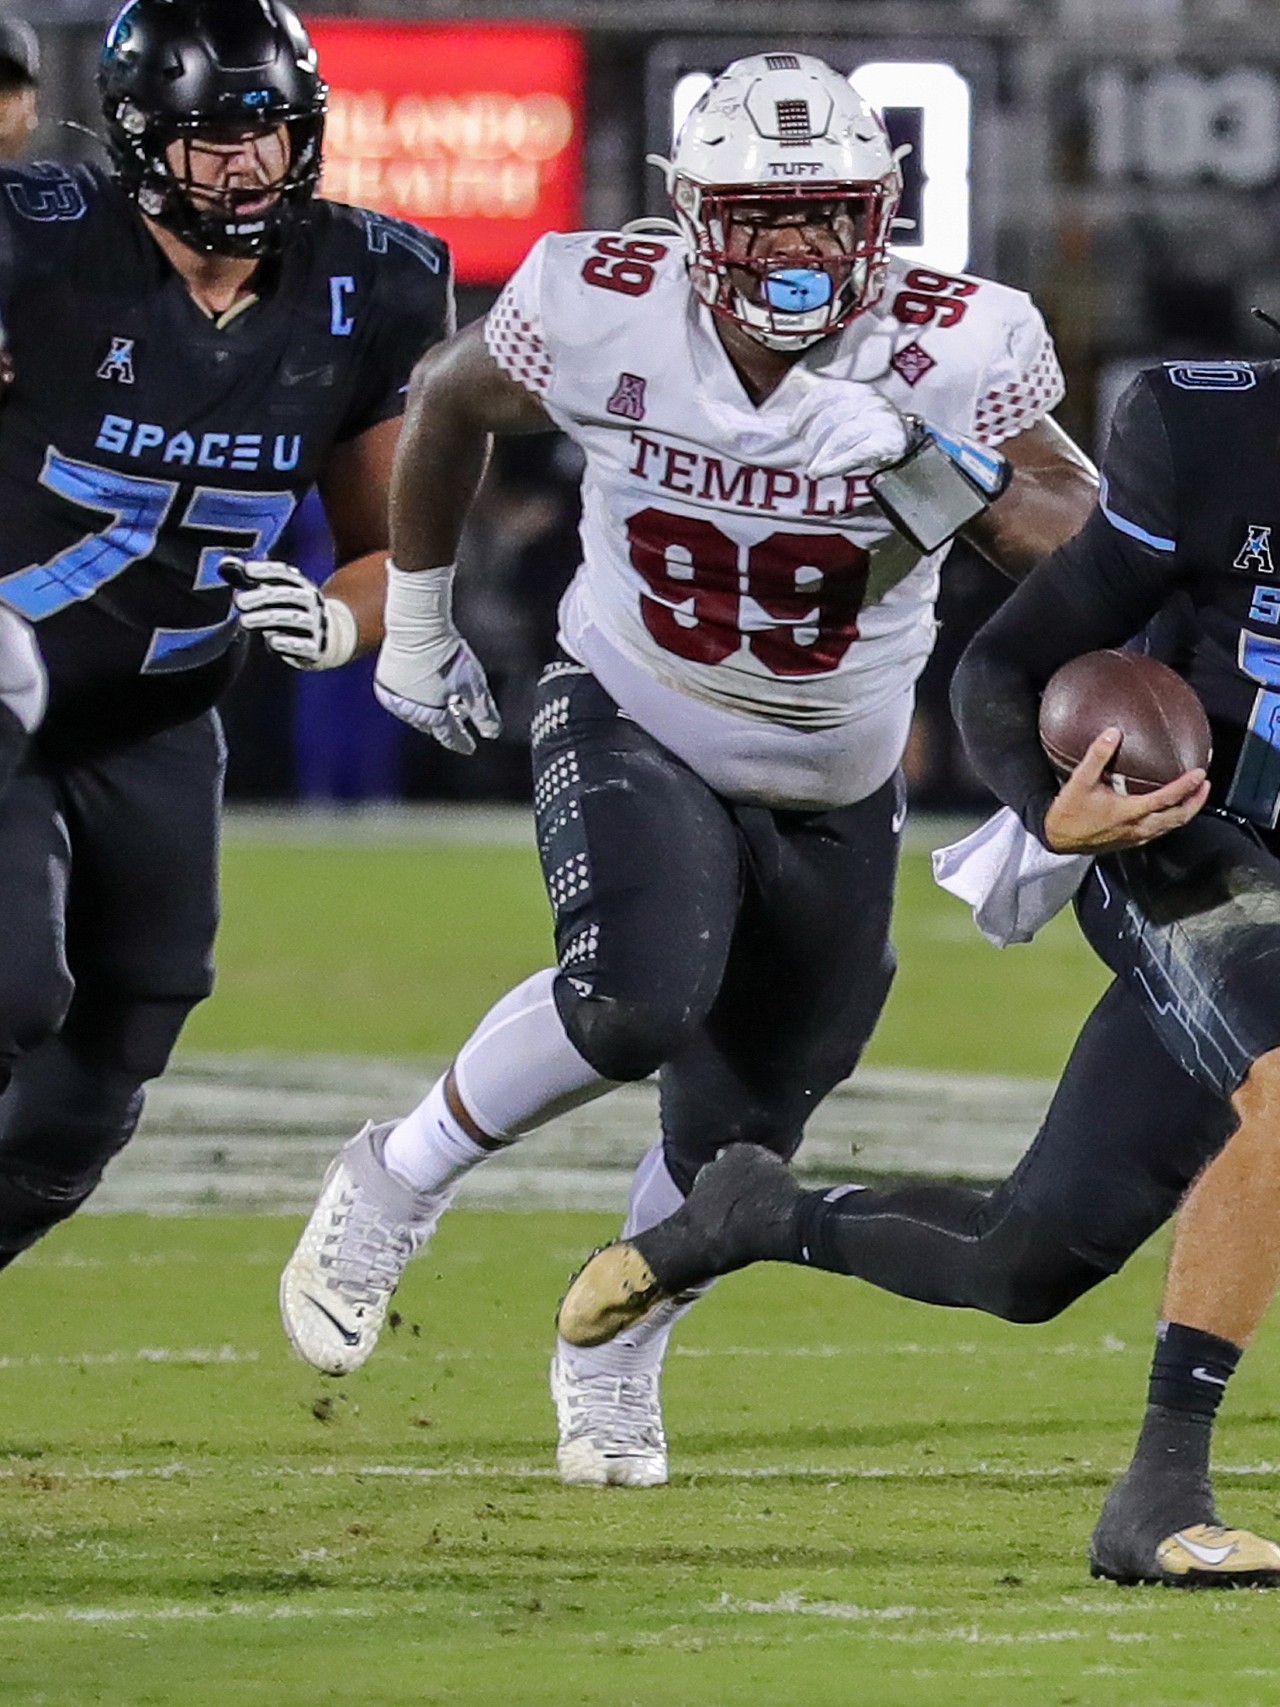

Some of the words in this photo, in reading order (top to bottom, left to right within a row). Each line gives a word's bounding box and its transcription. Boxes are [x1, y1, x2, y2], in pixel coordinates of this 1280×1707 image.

[768, 162, 824, 176] TUFF
[582, 236, 671, 298] 99
[328, 275, 356, 336] C
[892, 269, 981, 329] 99
[95, 414, 263, 472] SPACE
[272, 434, 301, 472] U
[0, 444, 297, 675] 73
[626, 506, 872, 676] 99
